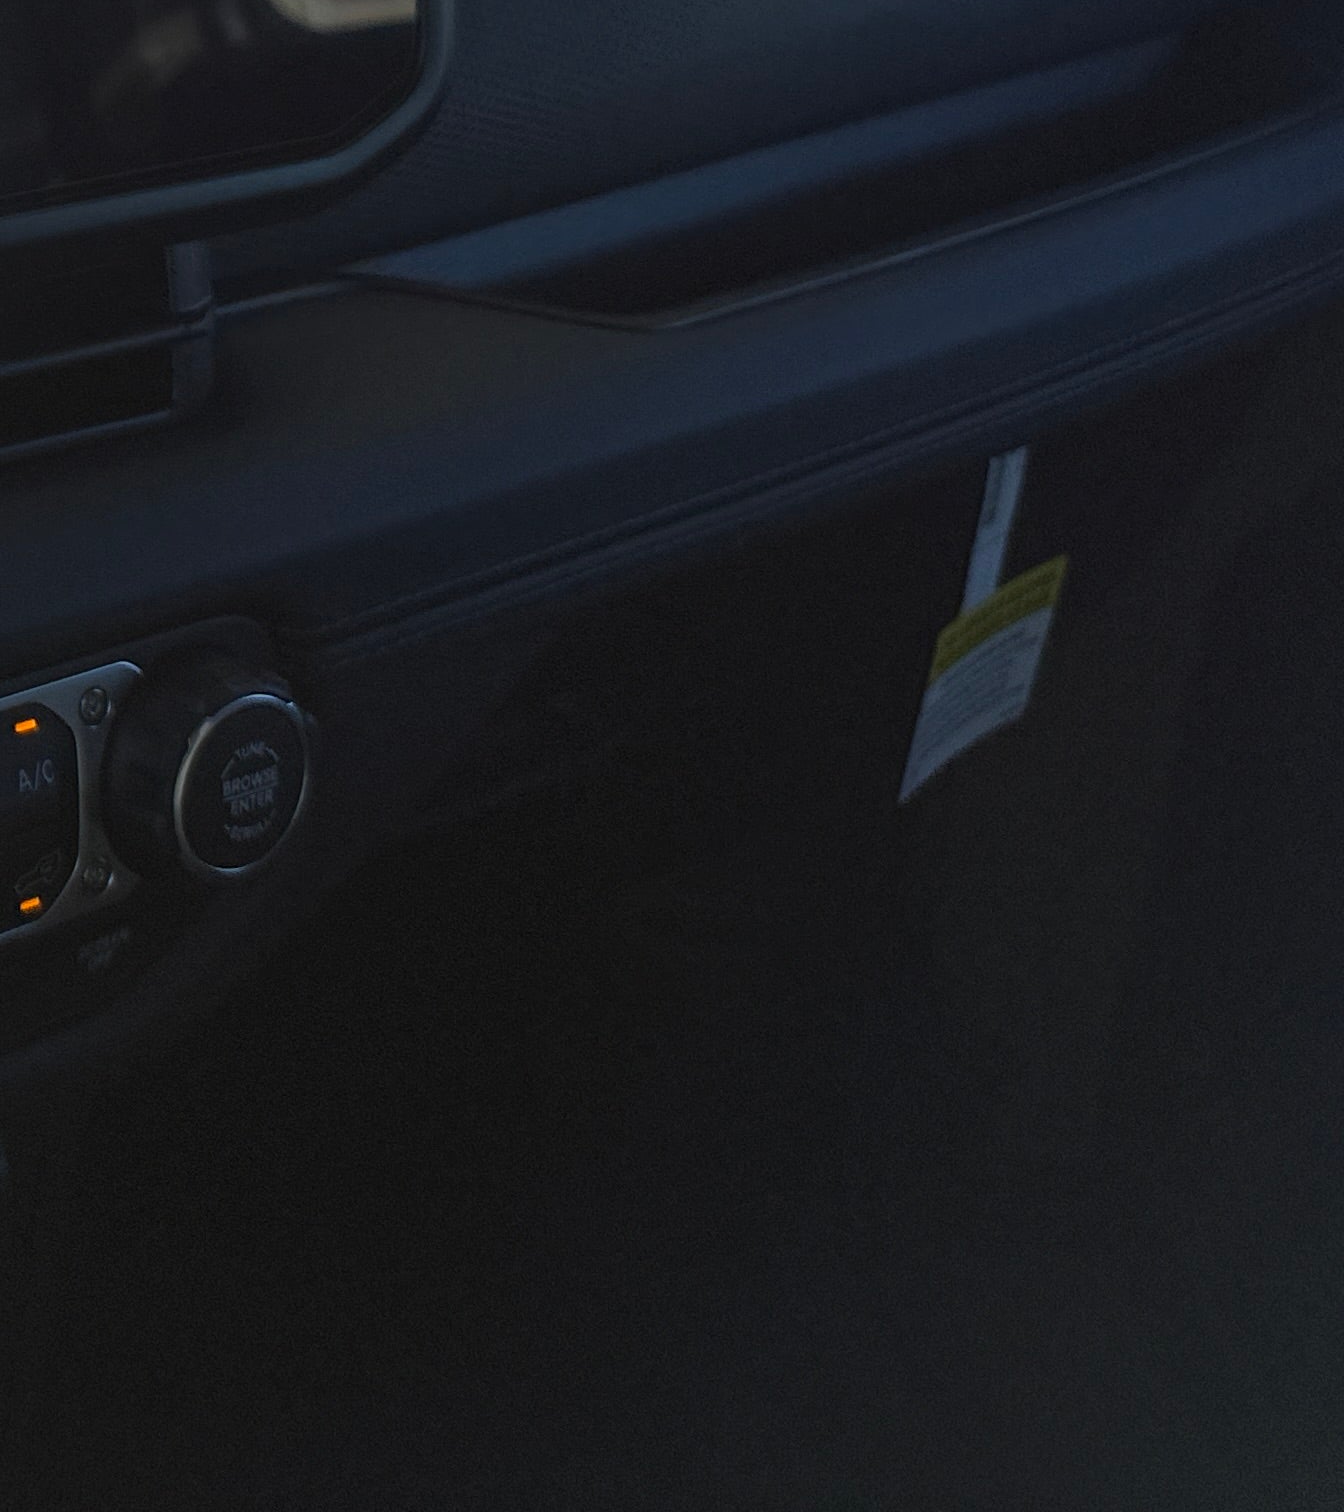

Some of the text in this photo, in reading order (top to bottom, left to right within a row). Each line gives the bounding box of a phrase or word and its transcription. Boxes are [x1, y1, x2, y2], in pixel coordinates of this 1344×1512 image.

[18, 758, 56, 793] A/C
[222, 764, 278, 797] BROWSE
[230, 788, 275, 817] ENTER
